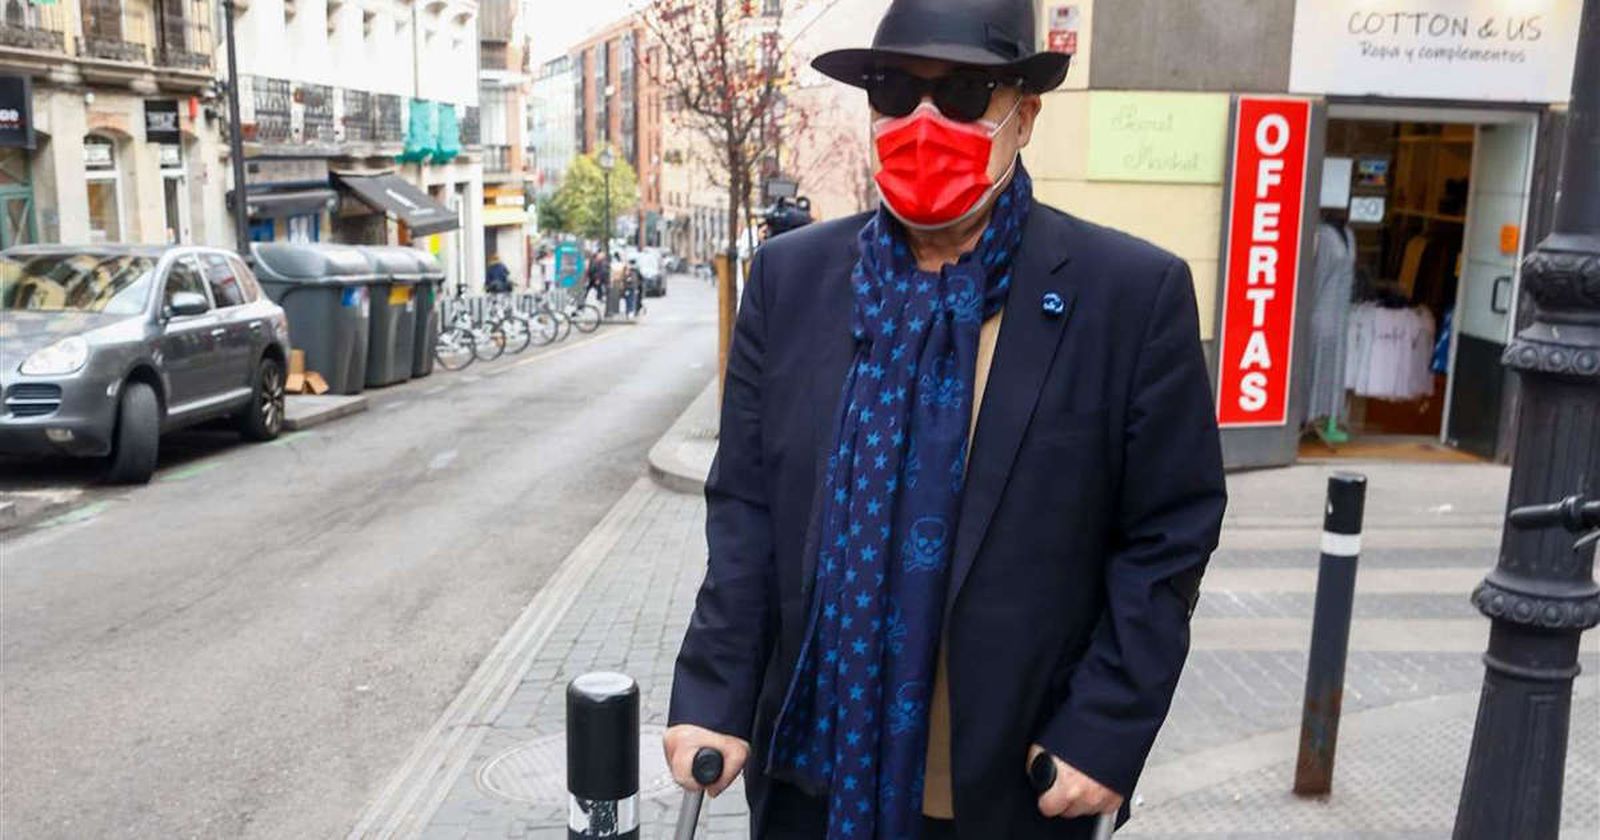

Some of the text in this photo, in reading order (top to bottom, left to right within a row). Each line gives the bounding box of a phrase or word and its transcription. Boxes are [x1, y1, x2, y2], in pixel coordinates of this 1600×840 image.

[1348, 12, 1542, 42] COTTON & US
[1359, 41, 1526, 63] Ropa y complementos
[1238, 113, 1291, 412] OFERTAS
